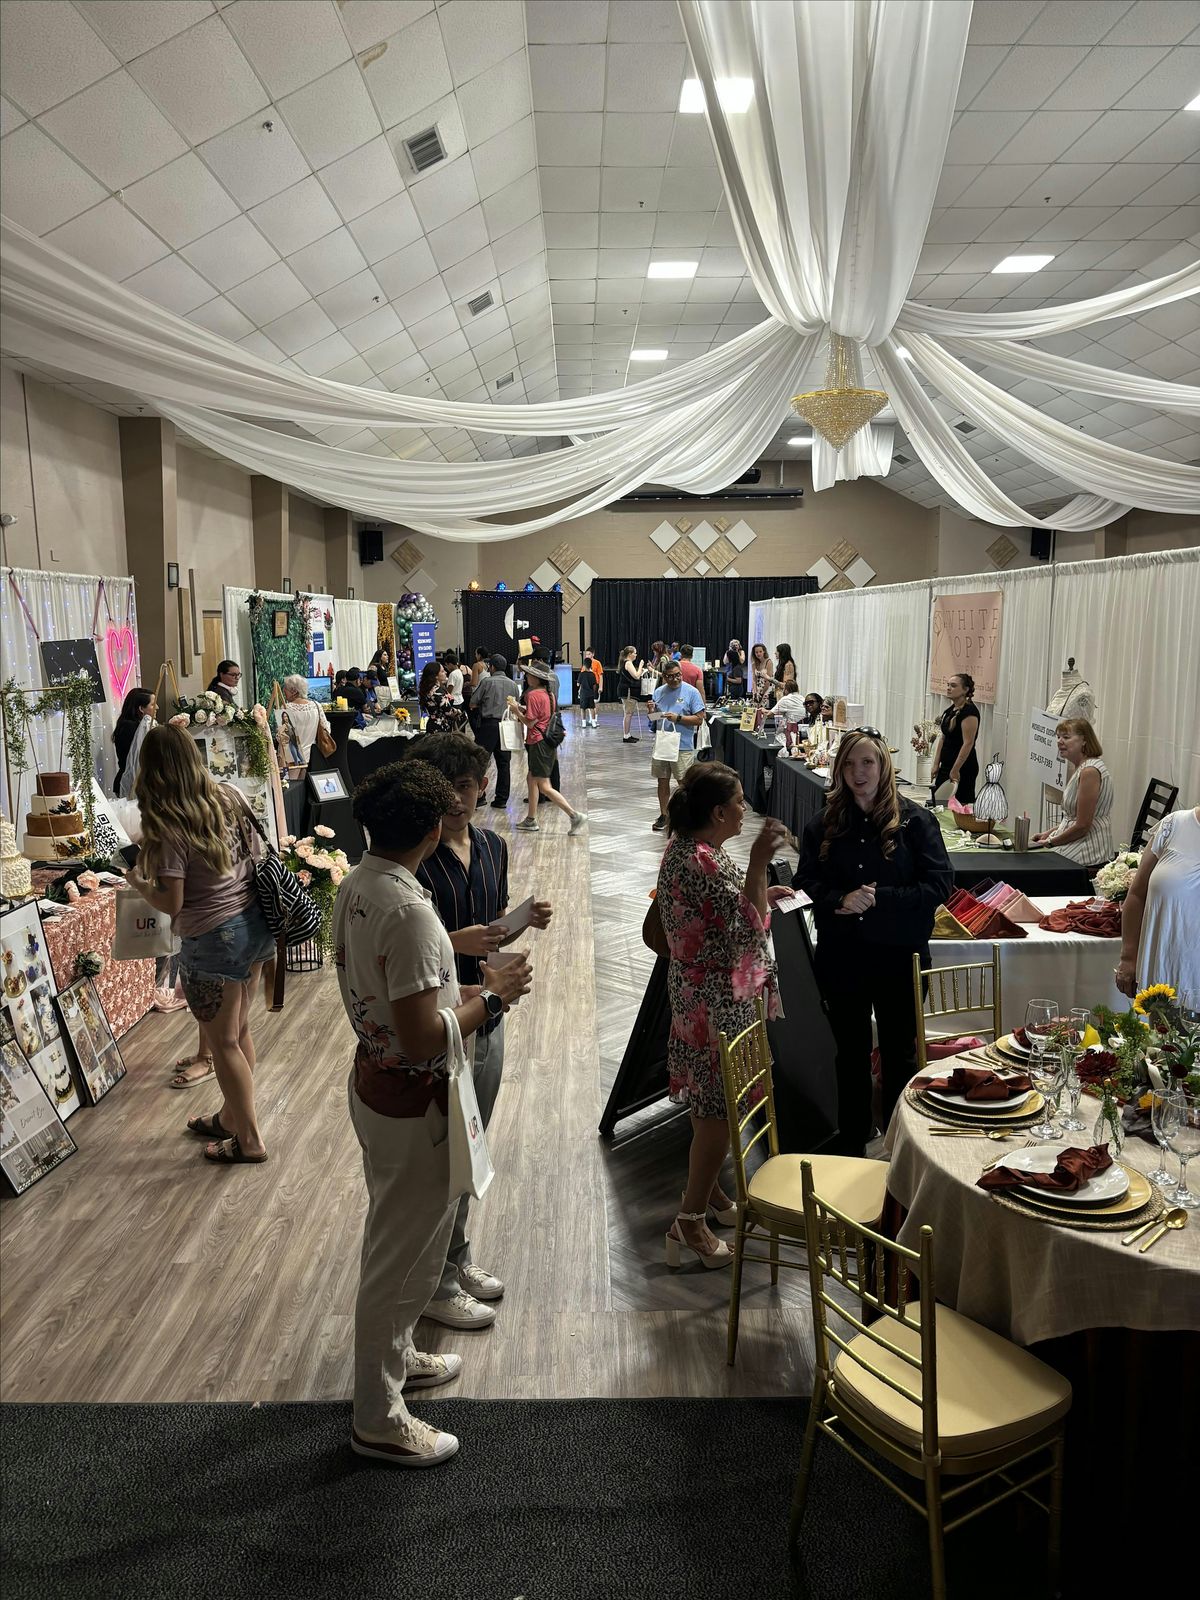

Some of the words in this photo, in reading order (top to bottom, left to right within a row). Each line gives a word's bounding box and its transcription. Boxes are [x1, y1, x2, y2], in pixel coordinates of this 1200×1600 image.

[943, 607, 999, 631] WHITE
[948, 635, 996, 659] OPPY
[136, 917, 157, 930] UR
